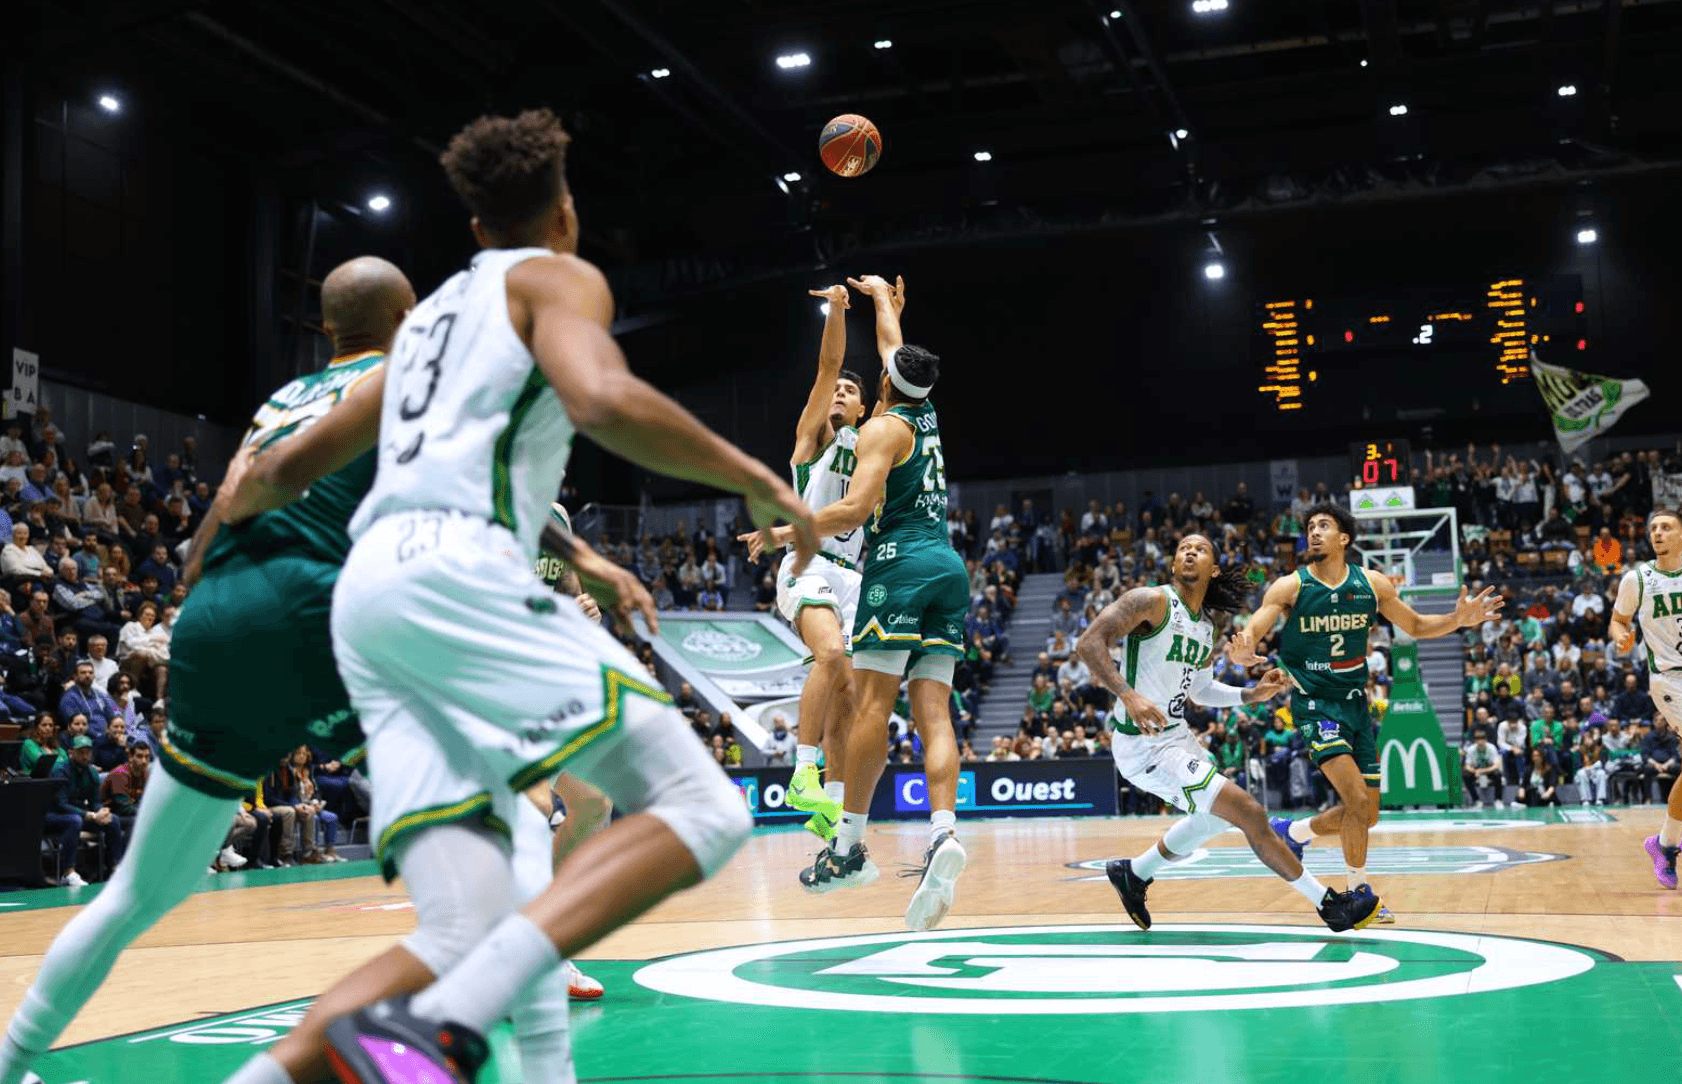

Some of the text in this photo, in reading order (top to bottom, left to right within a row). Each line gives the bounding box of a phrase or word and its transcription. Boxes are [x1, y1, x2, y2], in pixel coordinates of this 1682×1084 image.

[15, 360, 36, 378] VIP
[14, 386, 35, 404] B A
[1363, 459, 1397, 483] 07
[877, 542, 897, 561] 25
[1300, 614, 1369, 633] LIMOGES
[1330, 634, 1345, 656] 2
[991, 777, 1075, 801] Ouest
